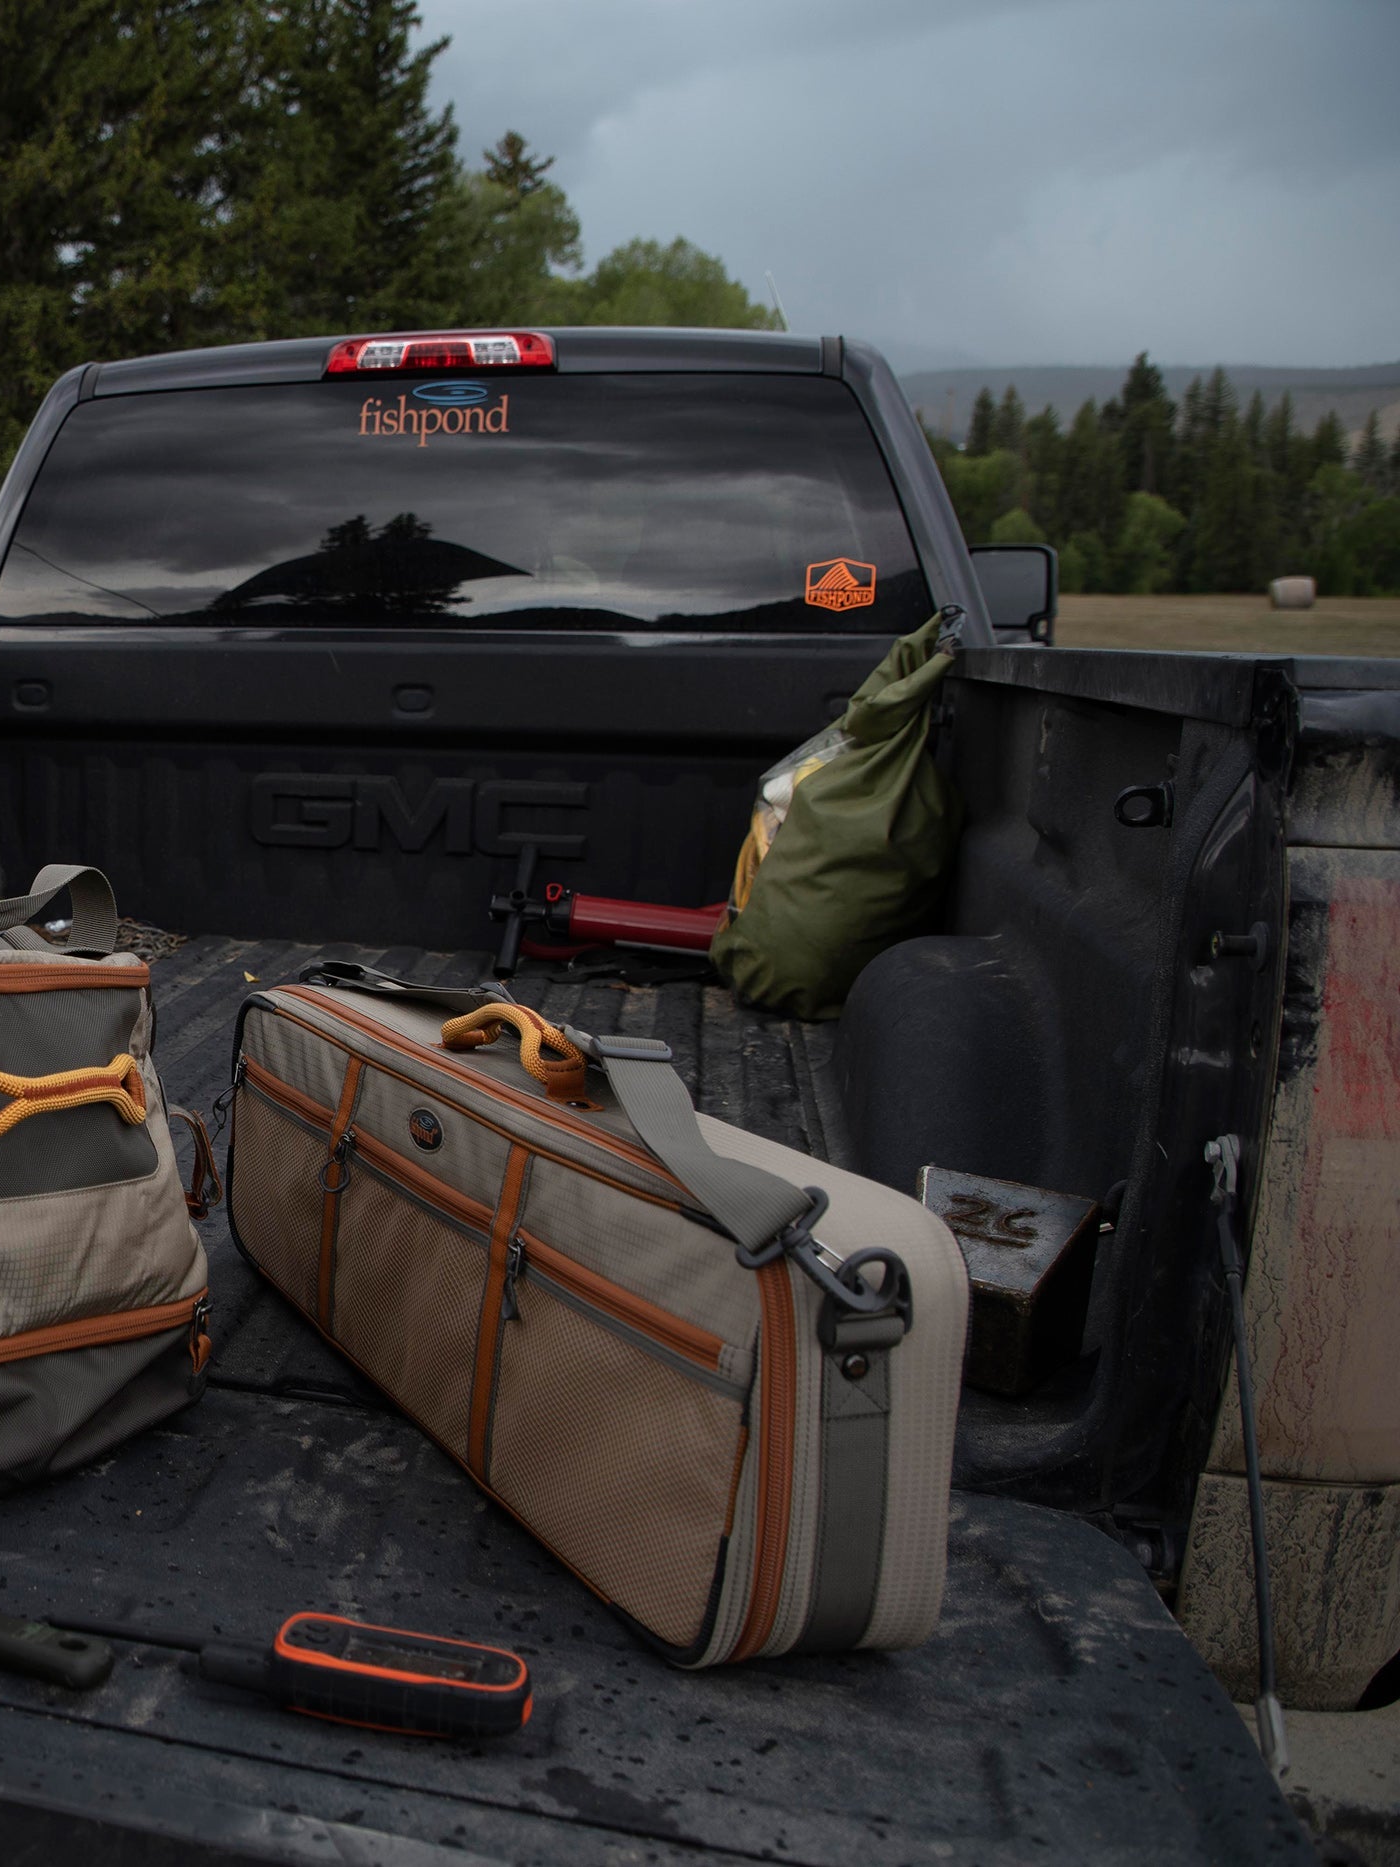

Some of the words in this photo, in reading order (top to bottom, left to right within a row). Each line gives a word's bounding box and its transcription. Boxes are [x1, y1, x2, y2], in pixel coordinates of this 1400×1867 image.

[358, 395, 510, 448] fishpond
[810, 590, 871, 608] FISHPOND
[251, 772, 589, 862] GMC
